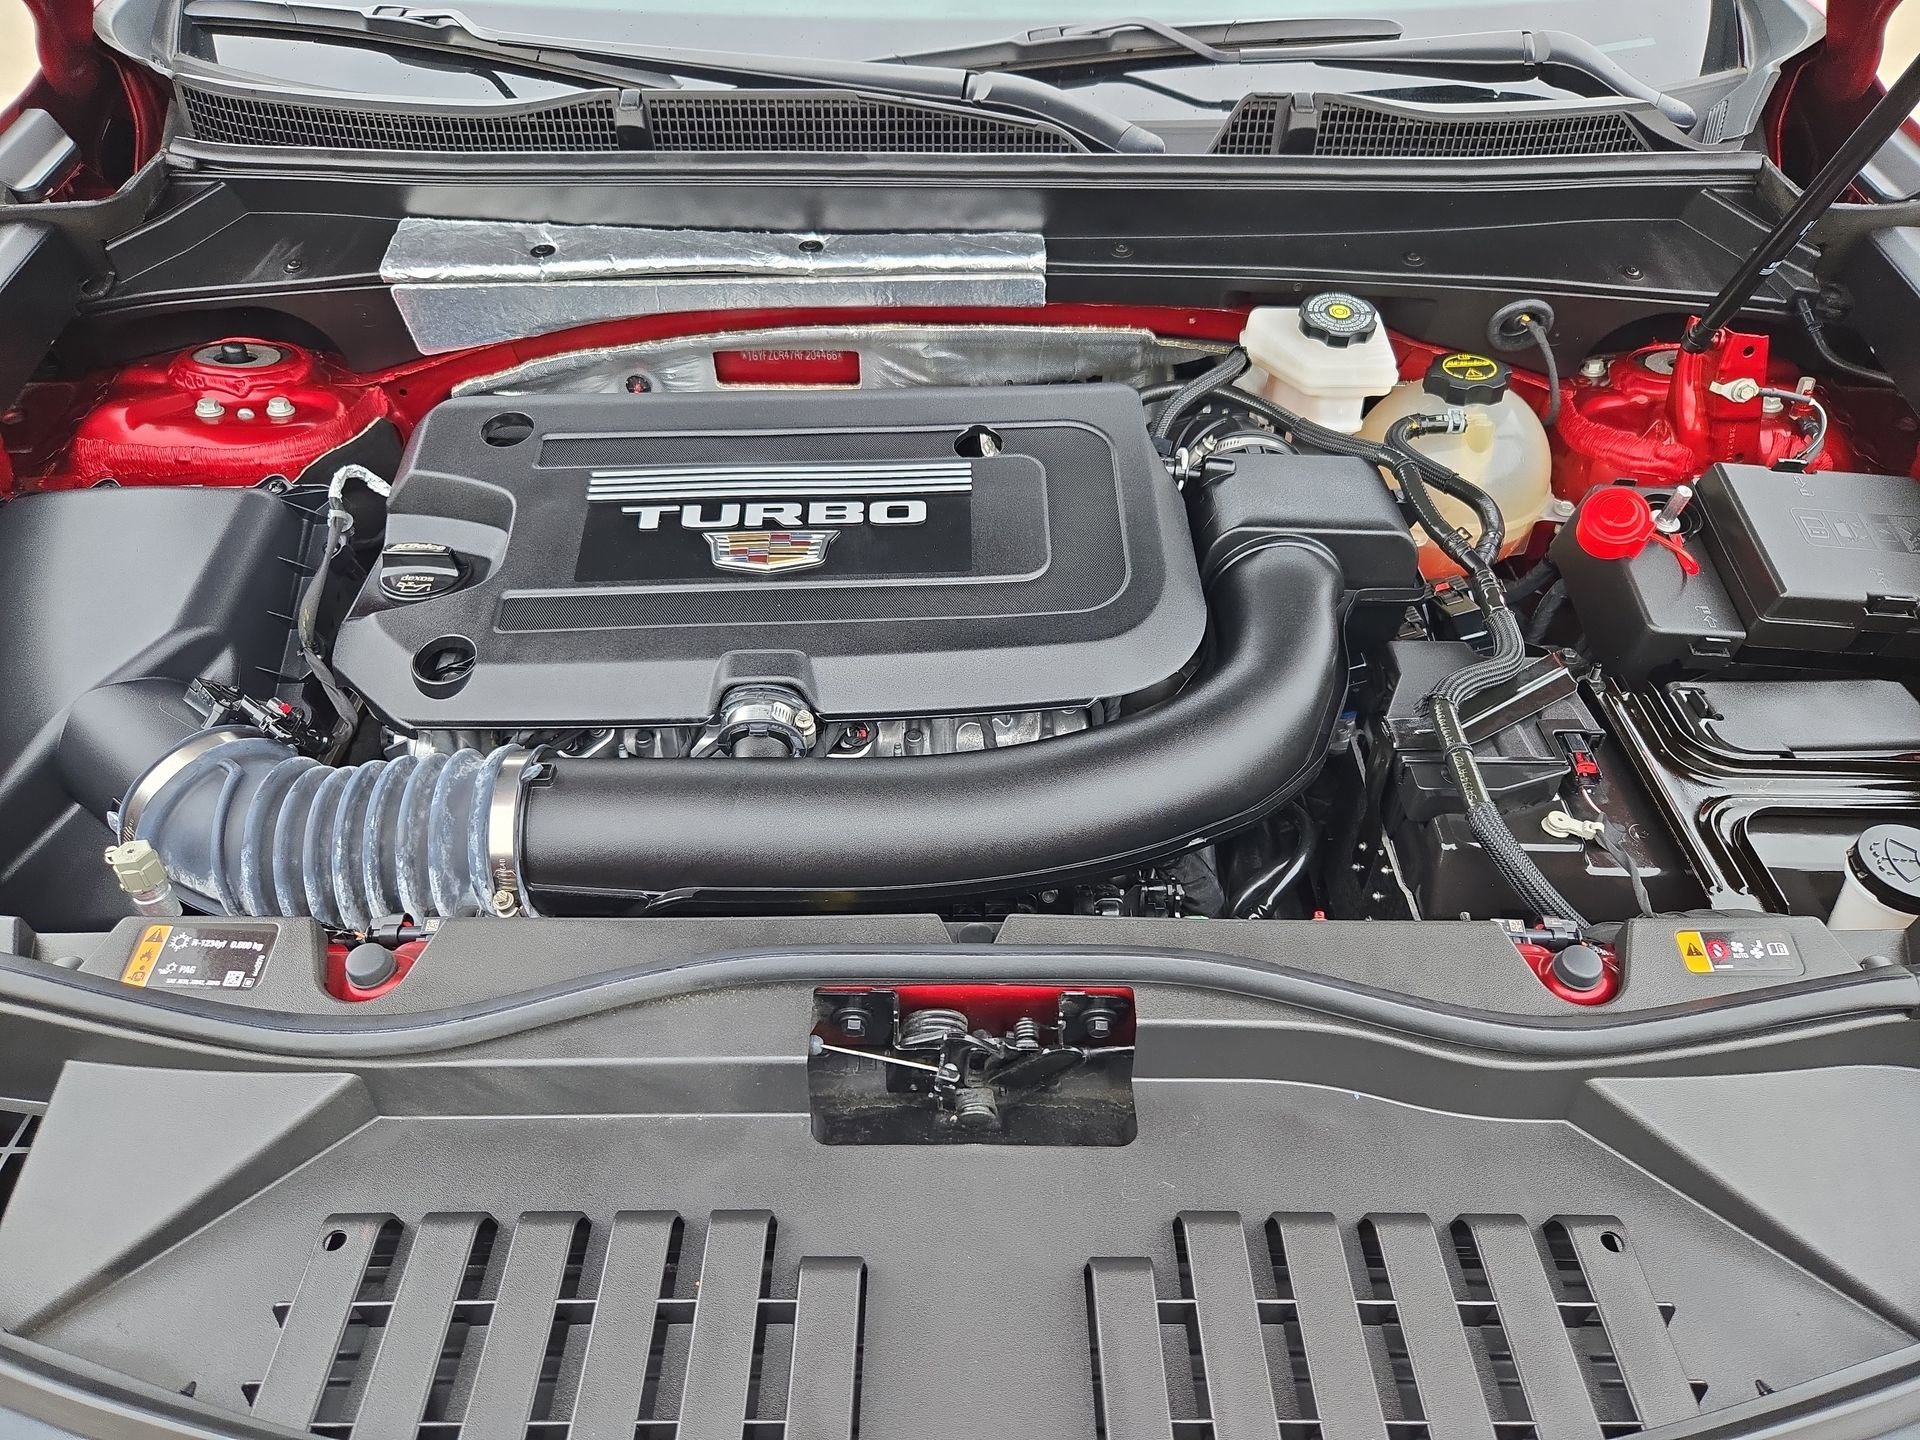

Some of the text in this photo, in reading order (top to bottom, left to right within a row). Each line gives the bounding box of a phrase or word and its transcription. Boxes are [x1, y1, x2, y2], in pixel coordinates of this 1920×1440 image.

[621, 500, 928, 531] TURBO
[400, 574, 435, 582] dexos
[178, 964, 197, 974] PAG
